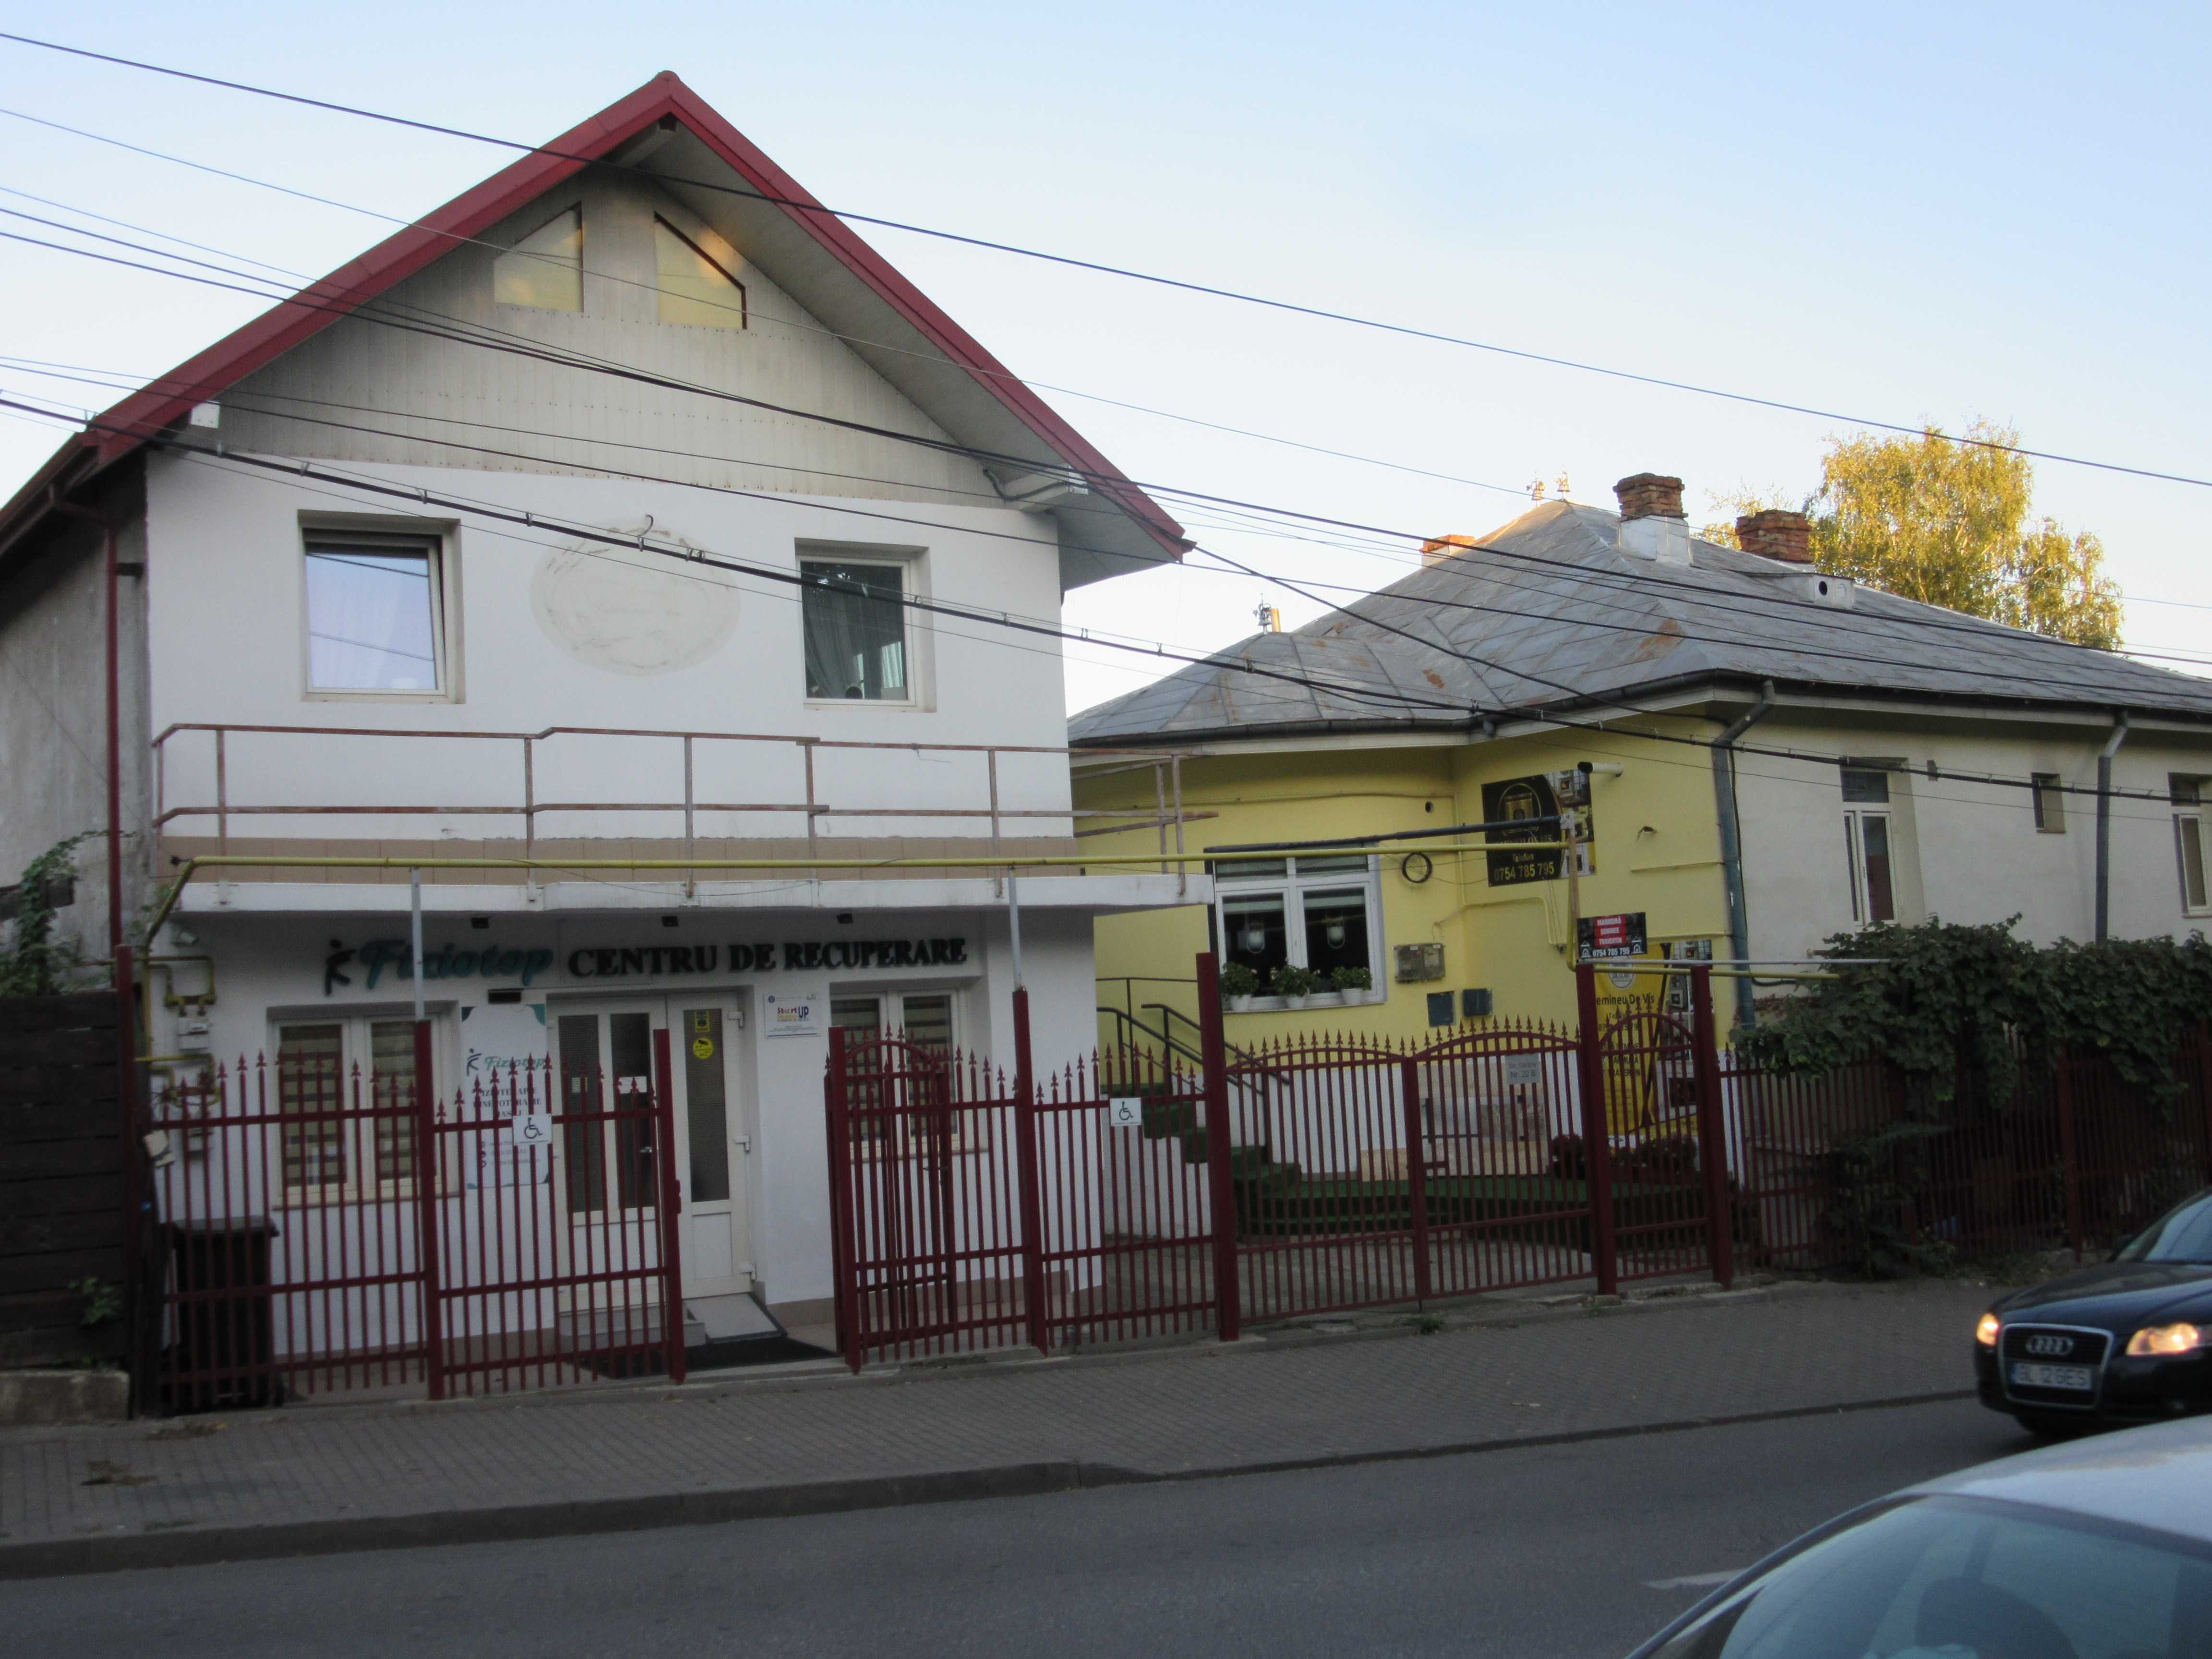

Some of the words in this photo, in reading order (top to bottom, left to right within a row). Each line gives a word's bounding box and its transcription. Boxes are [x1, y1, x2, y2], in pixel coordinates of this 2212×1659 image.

[1493, 866, 1516, 882] 0754
[1517, 864, 1536, 878] 785
[1537, 861, 1555, 876] 795
[568, 945, 718, 978] CENTRU
[729, 943, 776, 971] DE
[783, 938, 967, 970] RECUPERARE
[1592, 949, 1606, 957] 0754
[1597, 994, 1627, 1005] emineu
[798, 1006, 809, 1018] UP
